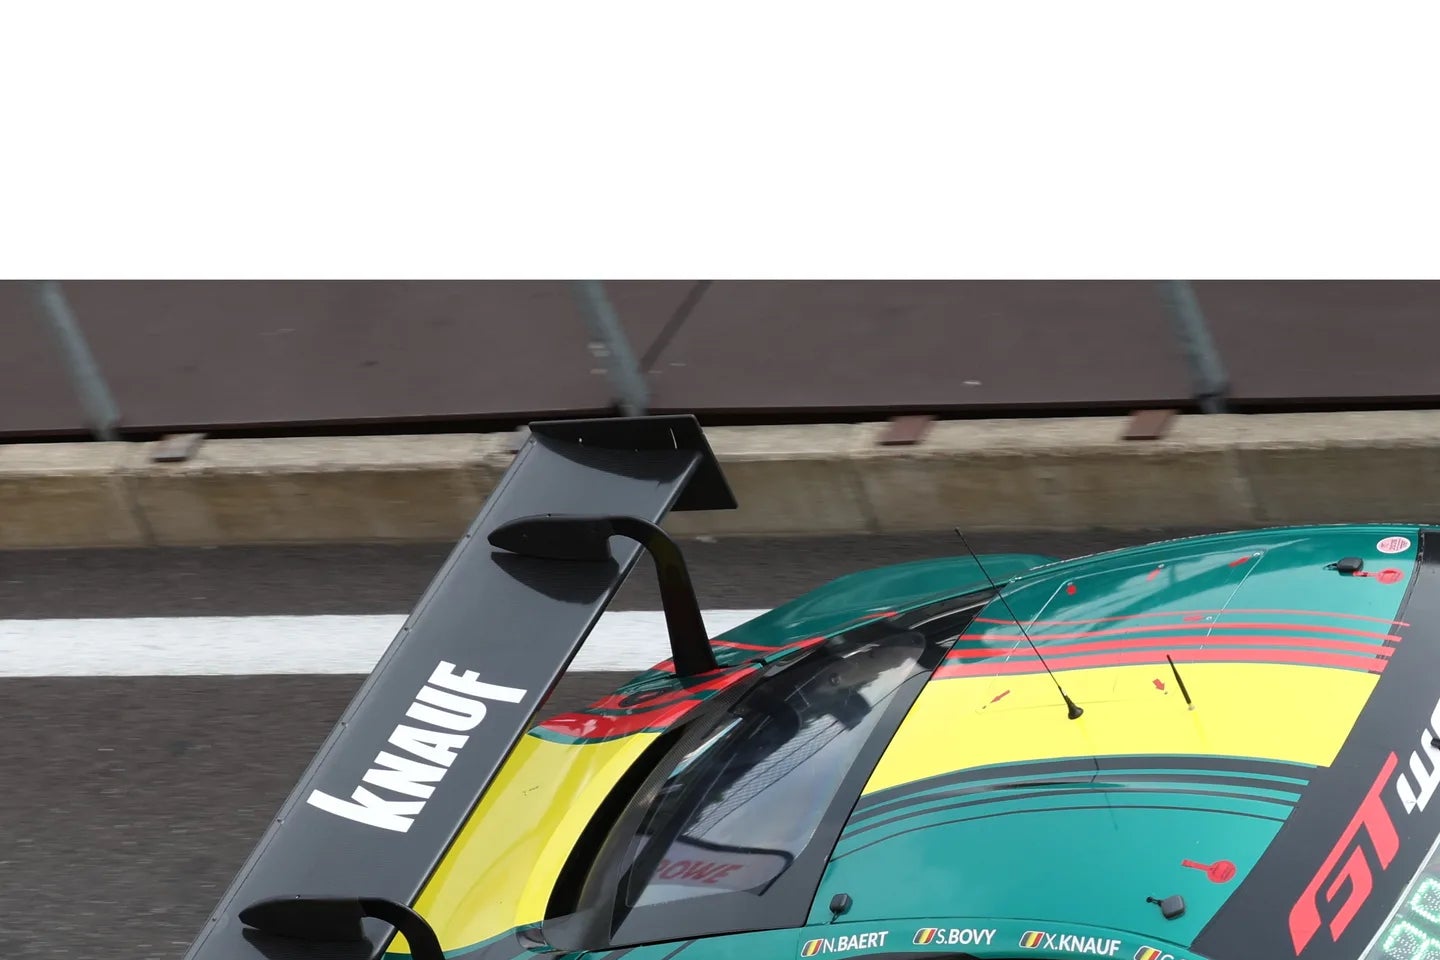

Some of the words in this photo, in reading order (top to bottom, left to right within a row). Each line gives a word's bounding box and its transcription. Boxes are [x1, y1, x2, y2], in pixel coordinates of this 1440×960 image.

[306, 660, 527, 834] KNAUF
[1288, 751, 1400, 956] GT
[822, 931, 889, 954] N.BAERT
[935, 928, 997, 946] S.BOVY
[1042, 932, 1121, 957] X.KNAUF
